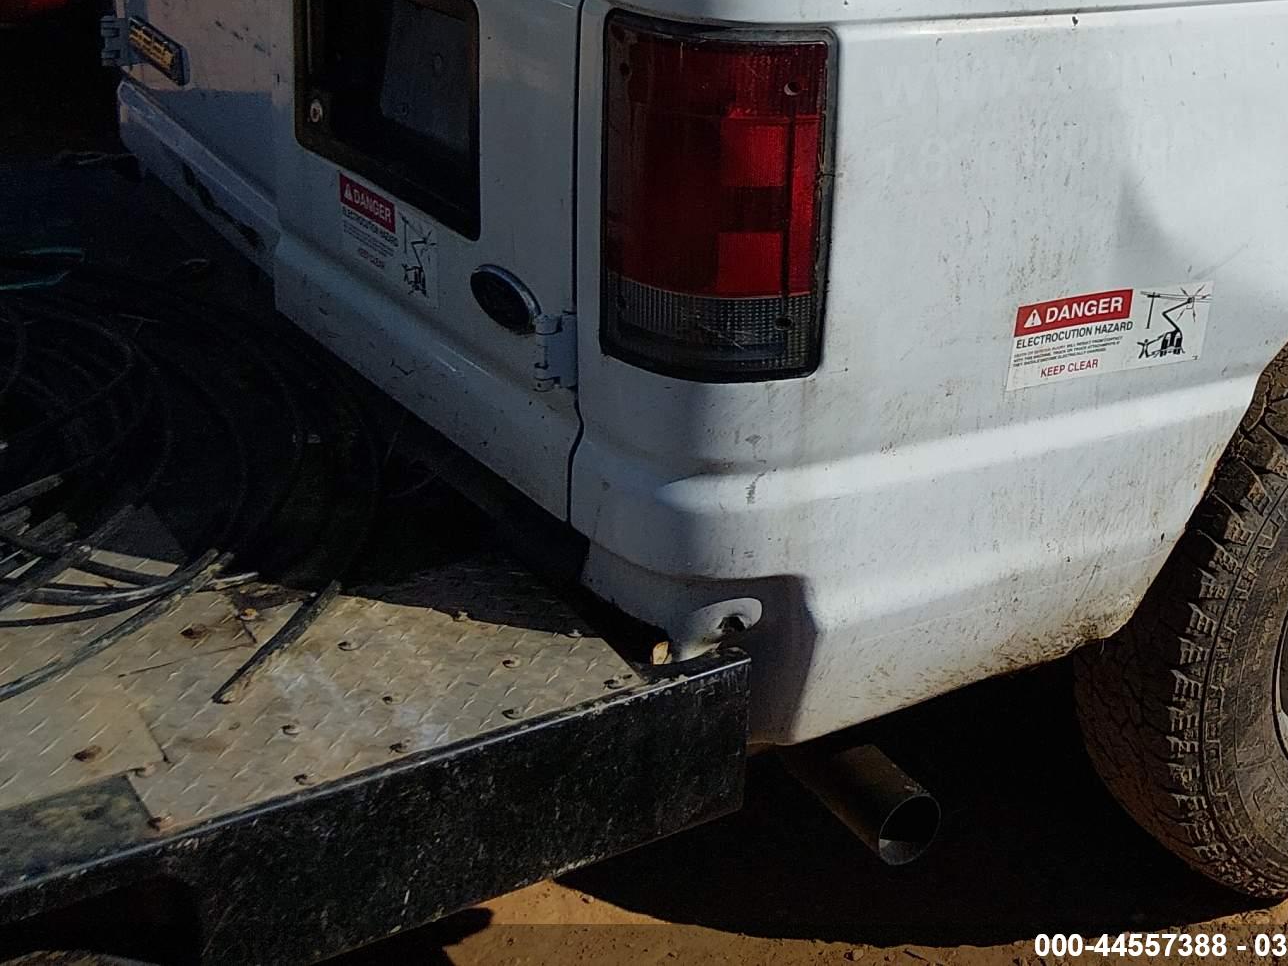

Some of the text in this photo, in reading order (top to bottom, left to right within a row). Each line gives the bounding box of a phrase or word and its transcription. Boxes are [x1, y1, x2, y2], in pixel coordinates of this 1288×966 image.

[353, 188, 393, 224] DANGER
[1045, 296, 1123, 324] DANGER
[1016, 321, 1133, 350] ELECTROCUTION HAZARD
[1040, 358, 1099, 379] KEEP CLEAR
